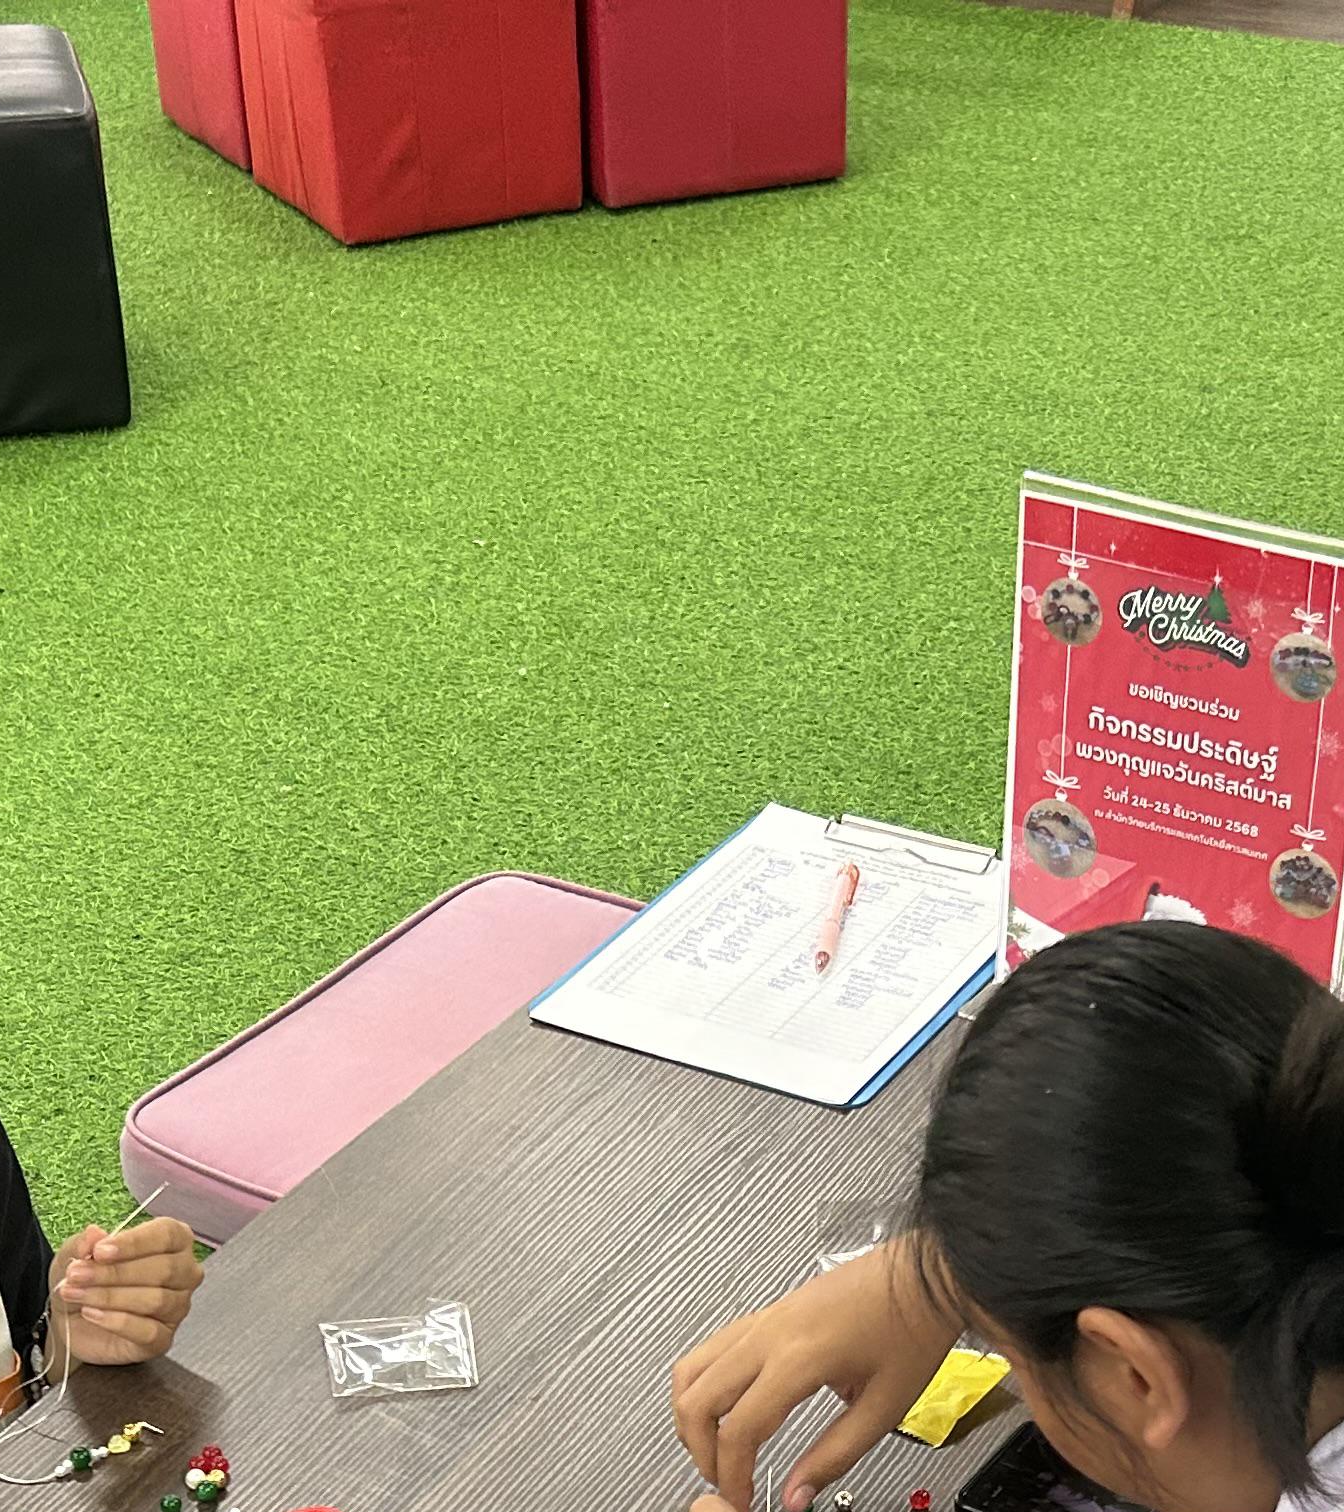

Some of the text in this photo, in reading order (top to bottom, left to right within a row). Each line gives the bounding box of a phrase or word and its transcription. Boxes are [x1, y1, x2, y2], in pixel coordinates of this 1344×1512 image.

[1119, 586, 1202, 628] Merry
[1148, 613, 1246, 659] Christmas
[1129, 682, 1240, 721] ขอเชิญชวนร่วม
[1088, 706, 1279, 782] กิจกรรมประดิษฐ์
[1076, 741, 1292, 810] พวงกุญแจวันคริสต์มาส
[1103, 785, 1259, 838] วันที่ 24-25 ธันวาคม 2568
